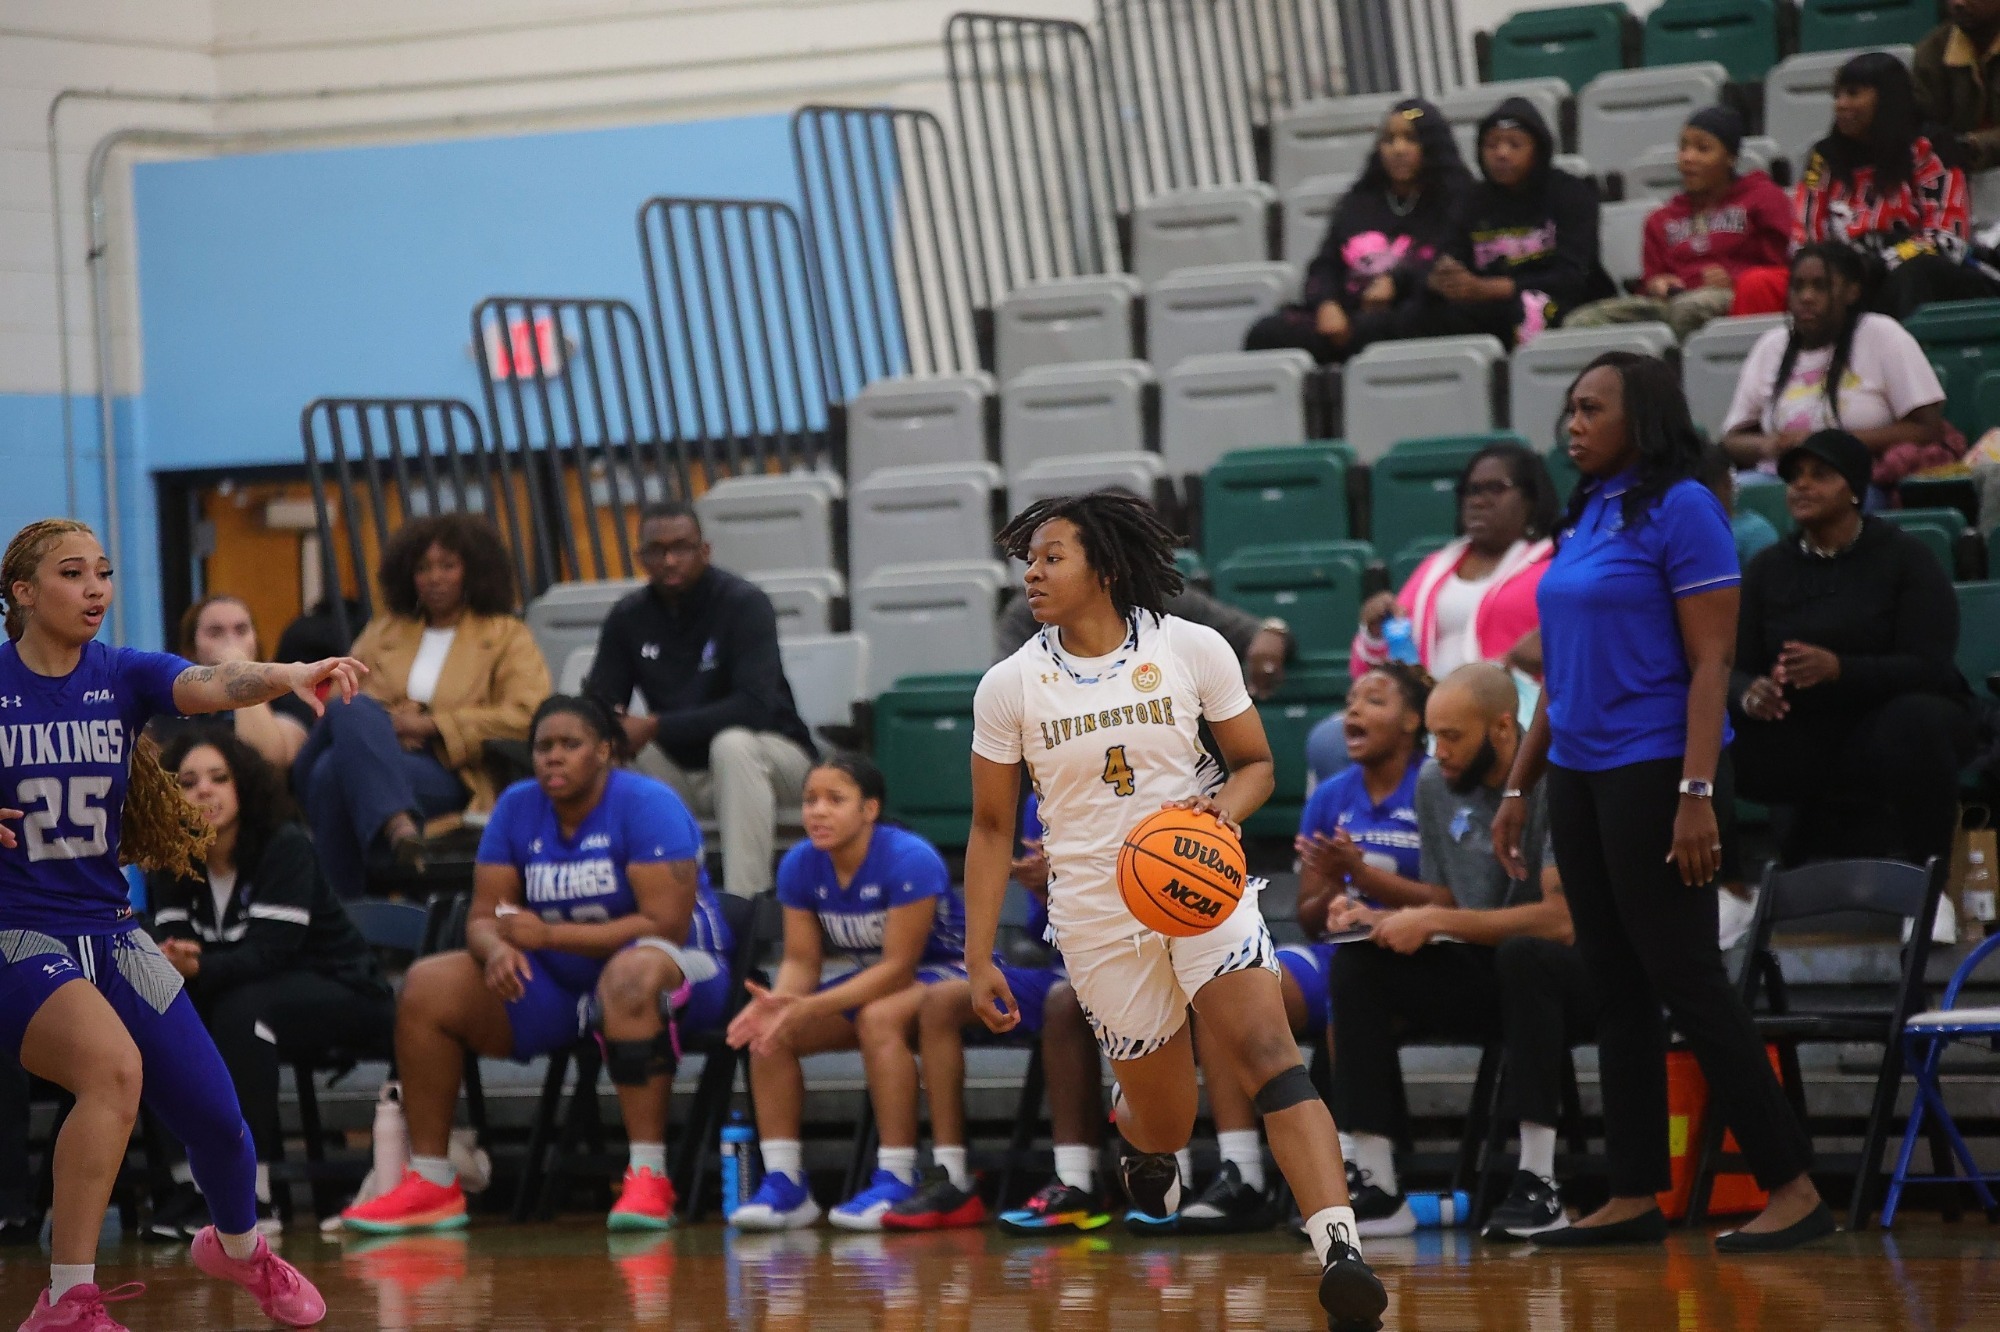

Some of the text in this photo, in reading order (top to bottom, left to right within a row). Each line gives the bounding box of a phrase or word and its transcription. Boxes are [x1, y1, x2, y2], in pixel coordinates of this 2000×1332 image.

[1138, 671, 1157, 686] 50
[0, 719, 123, 768] VIKINGS
[1040, 696, 1175, 750] LIVINGSTONE
[1101, 745, 1135, 797] 4
[16, 775, 113, 863] 25
[524, 858, 618, 903] VIKINGS
[1173, 835, 1242, 890] Wilson
[1161, 878, 1223, 919] NCAA
[817, 911, 887, 949] VIKING
